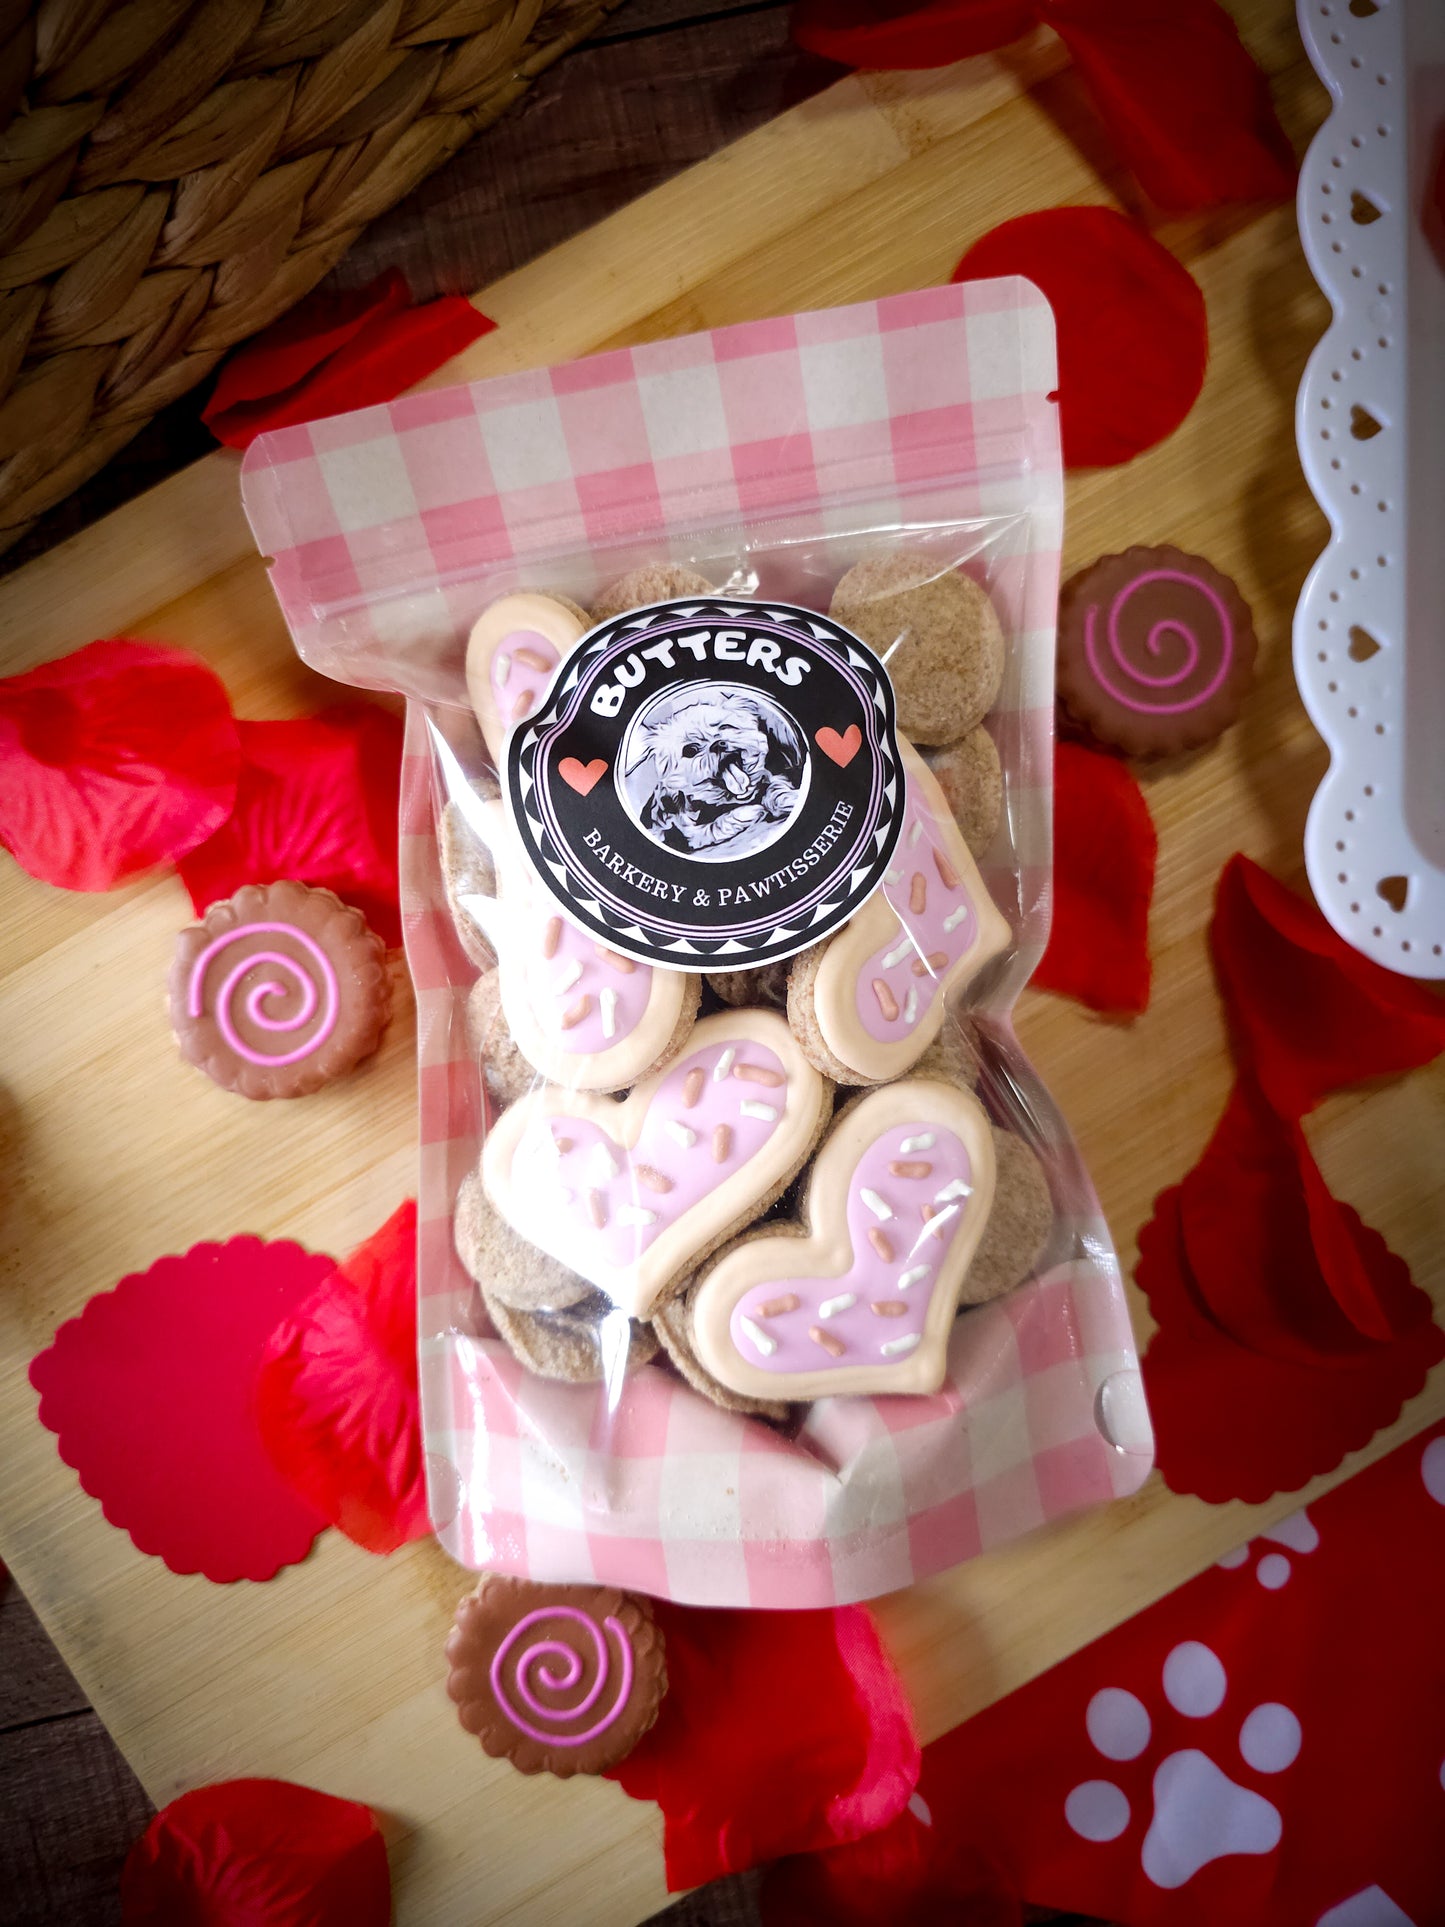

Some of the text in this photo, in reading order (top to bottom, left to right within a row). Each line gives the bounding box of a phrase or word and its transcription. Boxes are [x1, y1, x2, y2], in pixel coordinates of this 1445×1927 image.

[590, 631, 811, 718] BUTTERS
[582, 800, 854, 907] BARKERY & PAWTISSERIE
